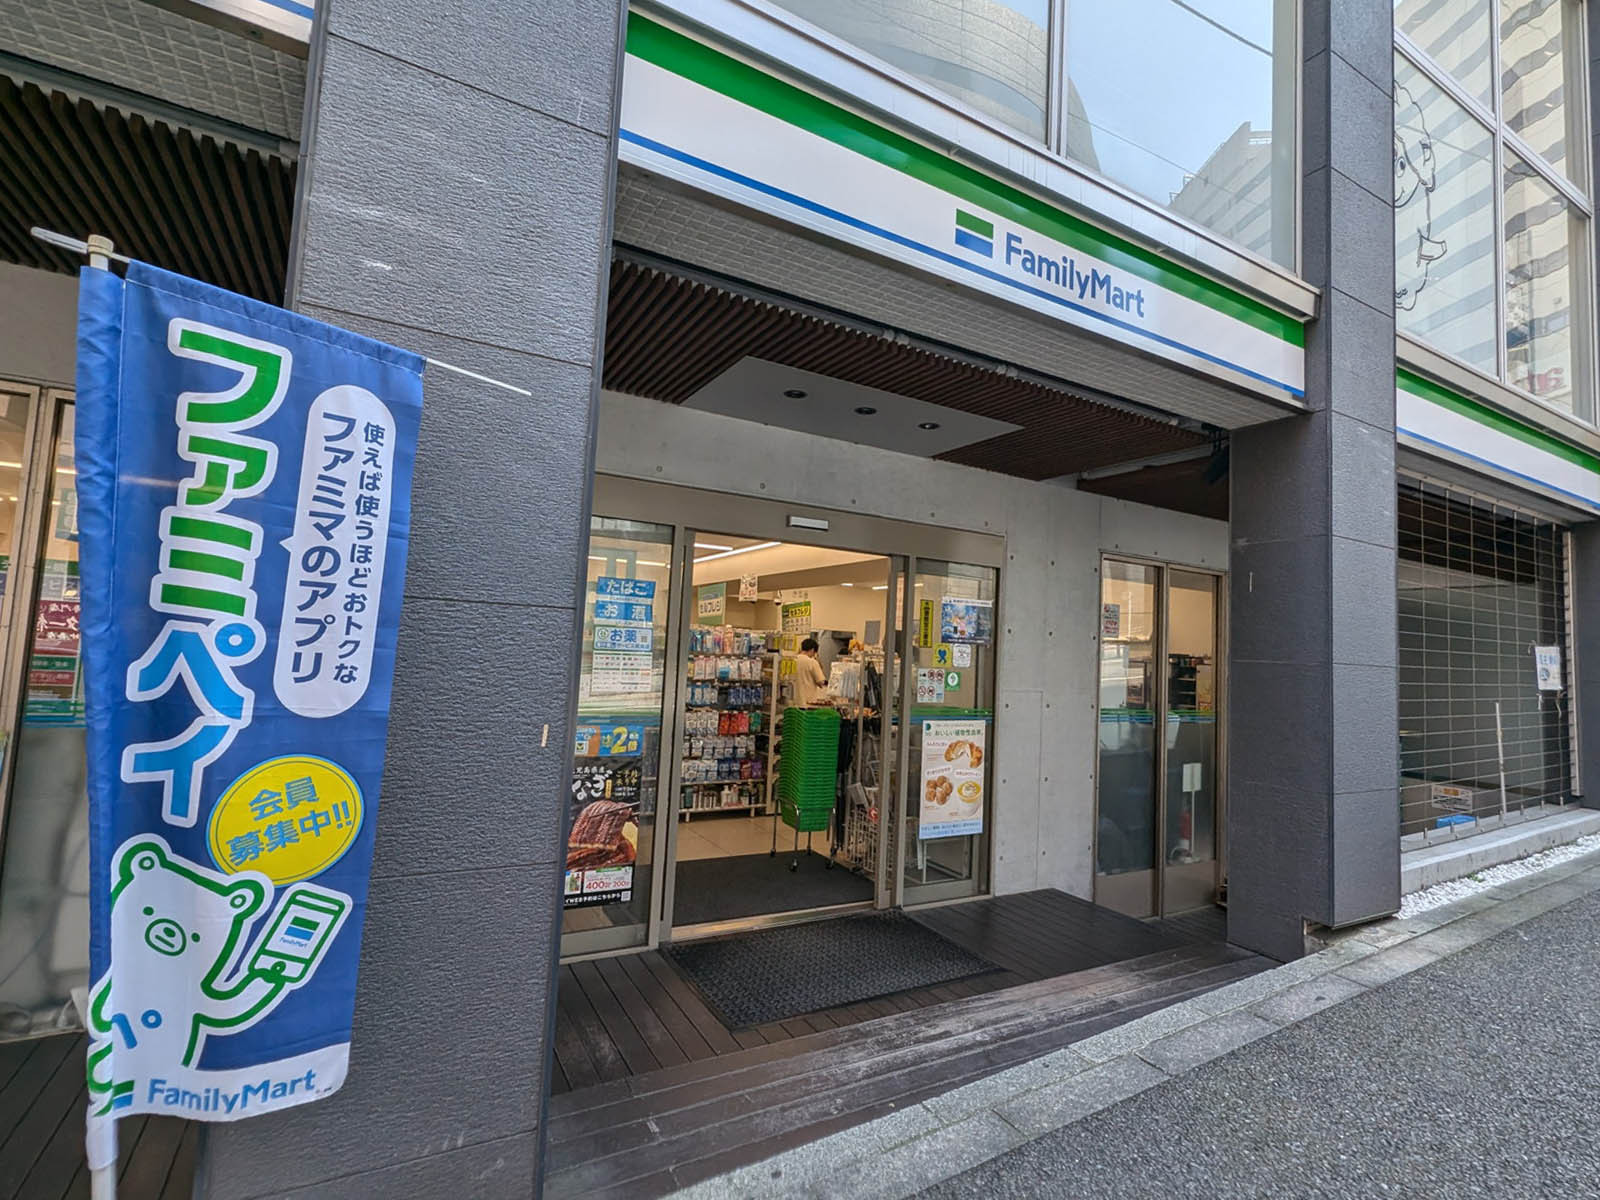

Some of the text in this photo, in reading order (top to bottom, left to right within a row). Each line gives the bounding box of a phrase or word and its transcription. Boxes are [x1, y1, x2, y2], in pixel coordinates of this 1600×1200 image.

[1004, 231, 1145, 318] FamilyMart
[124, 320, 290, 826] ファミペイ
[291, 412, 357, 684] ファミマのアプリ
[333, 422, 386, 684] 使えば使うほどおトクな
[606, 579, 648, 596] たばこ
[610, 629, 637, 643] お薬
[249, 776, 319, 821] 会員
[148, 1070, 317, 1114] FamilyMart
